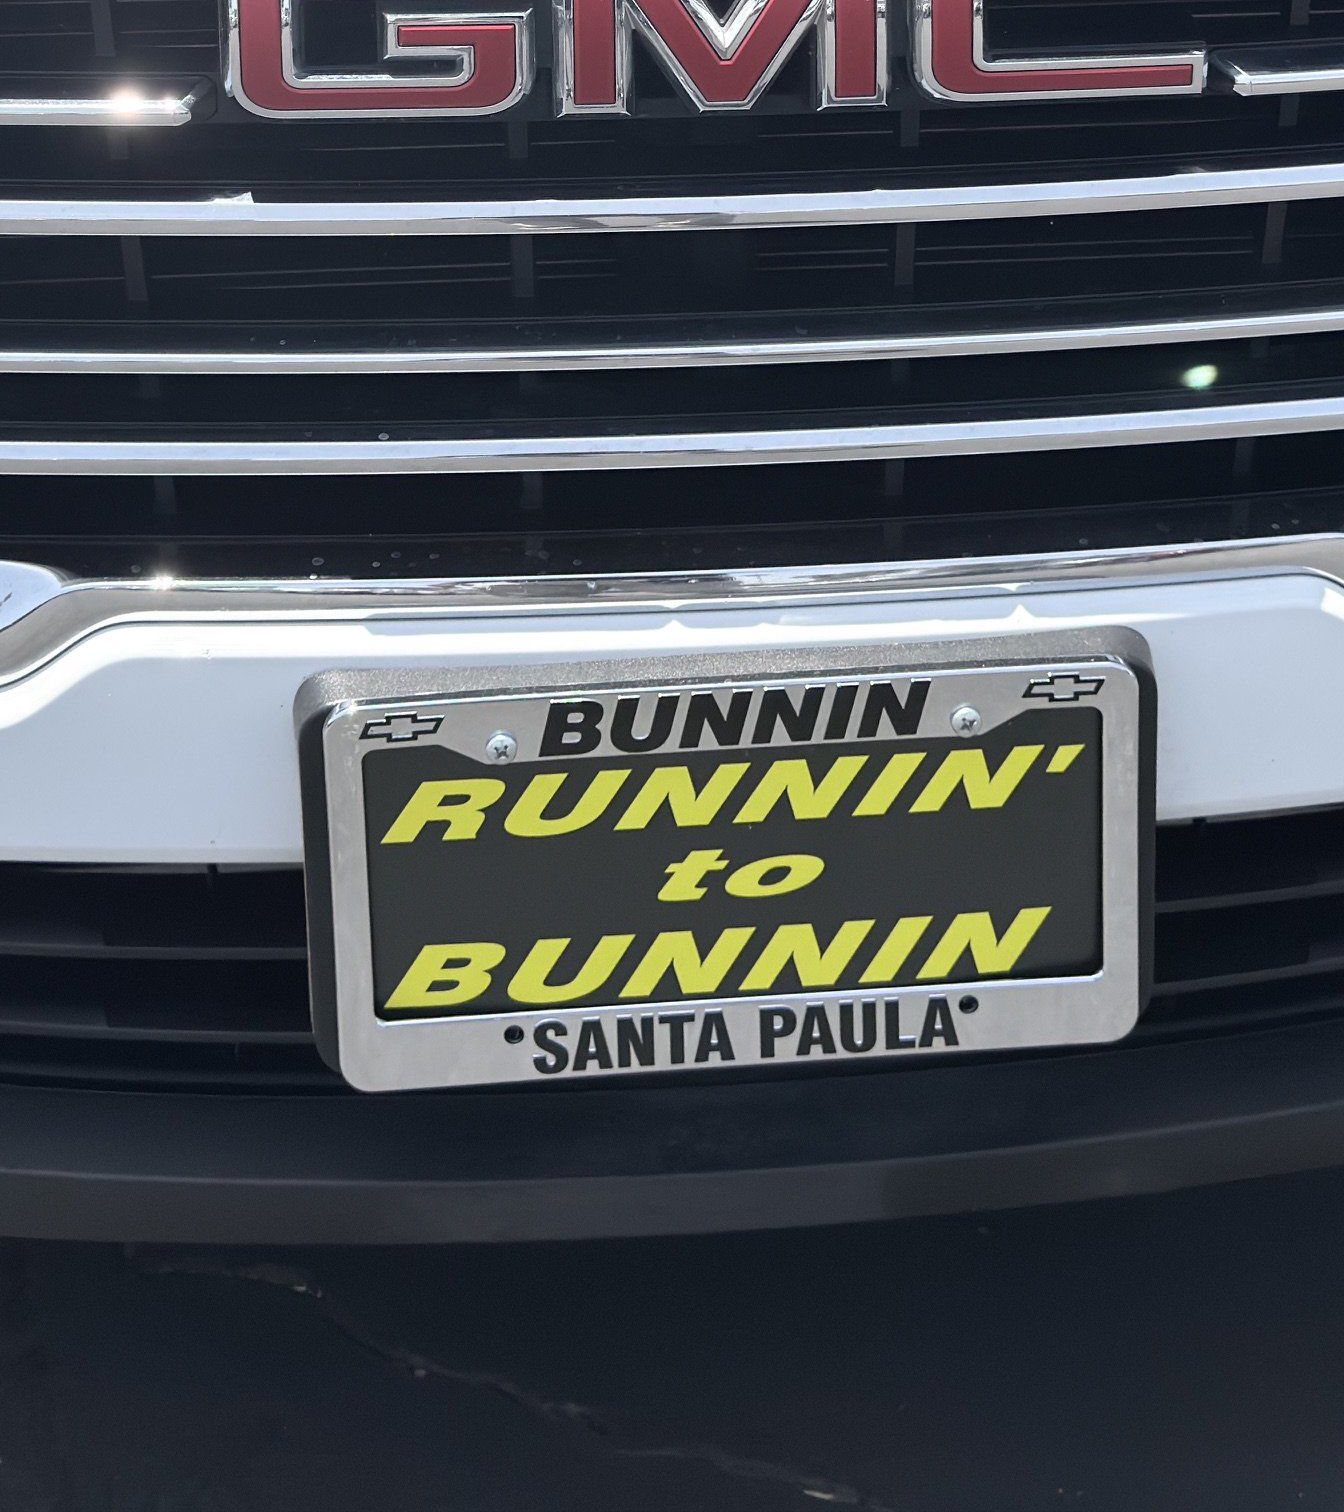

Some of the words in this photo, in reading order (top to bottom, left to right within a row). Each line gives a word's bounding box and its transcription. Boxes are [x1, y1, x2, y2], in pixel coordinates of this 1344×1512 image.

[539, 681, 932, 758] BUNNIN
[380, 744, 1086, 845] RUNNIN'
[657, 848, 826, 903] to
[384, 906, 1053, 1010] BUNNIN
[532, 1008, 736, 1076] SANTA
[759, 995, 959, 1060] PAULA
